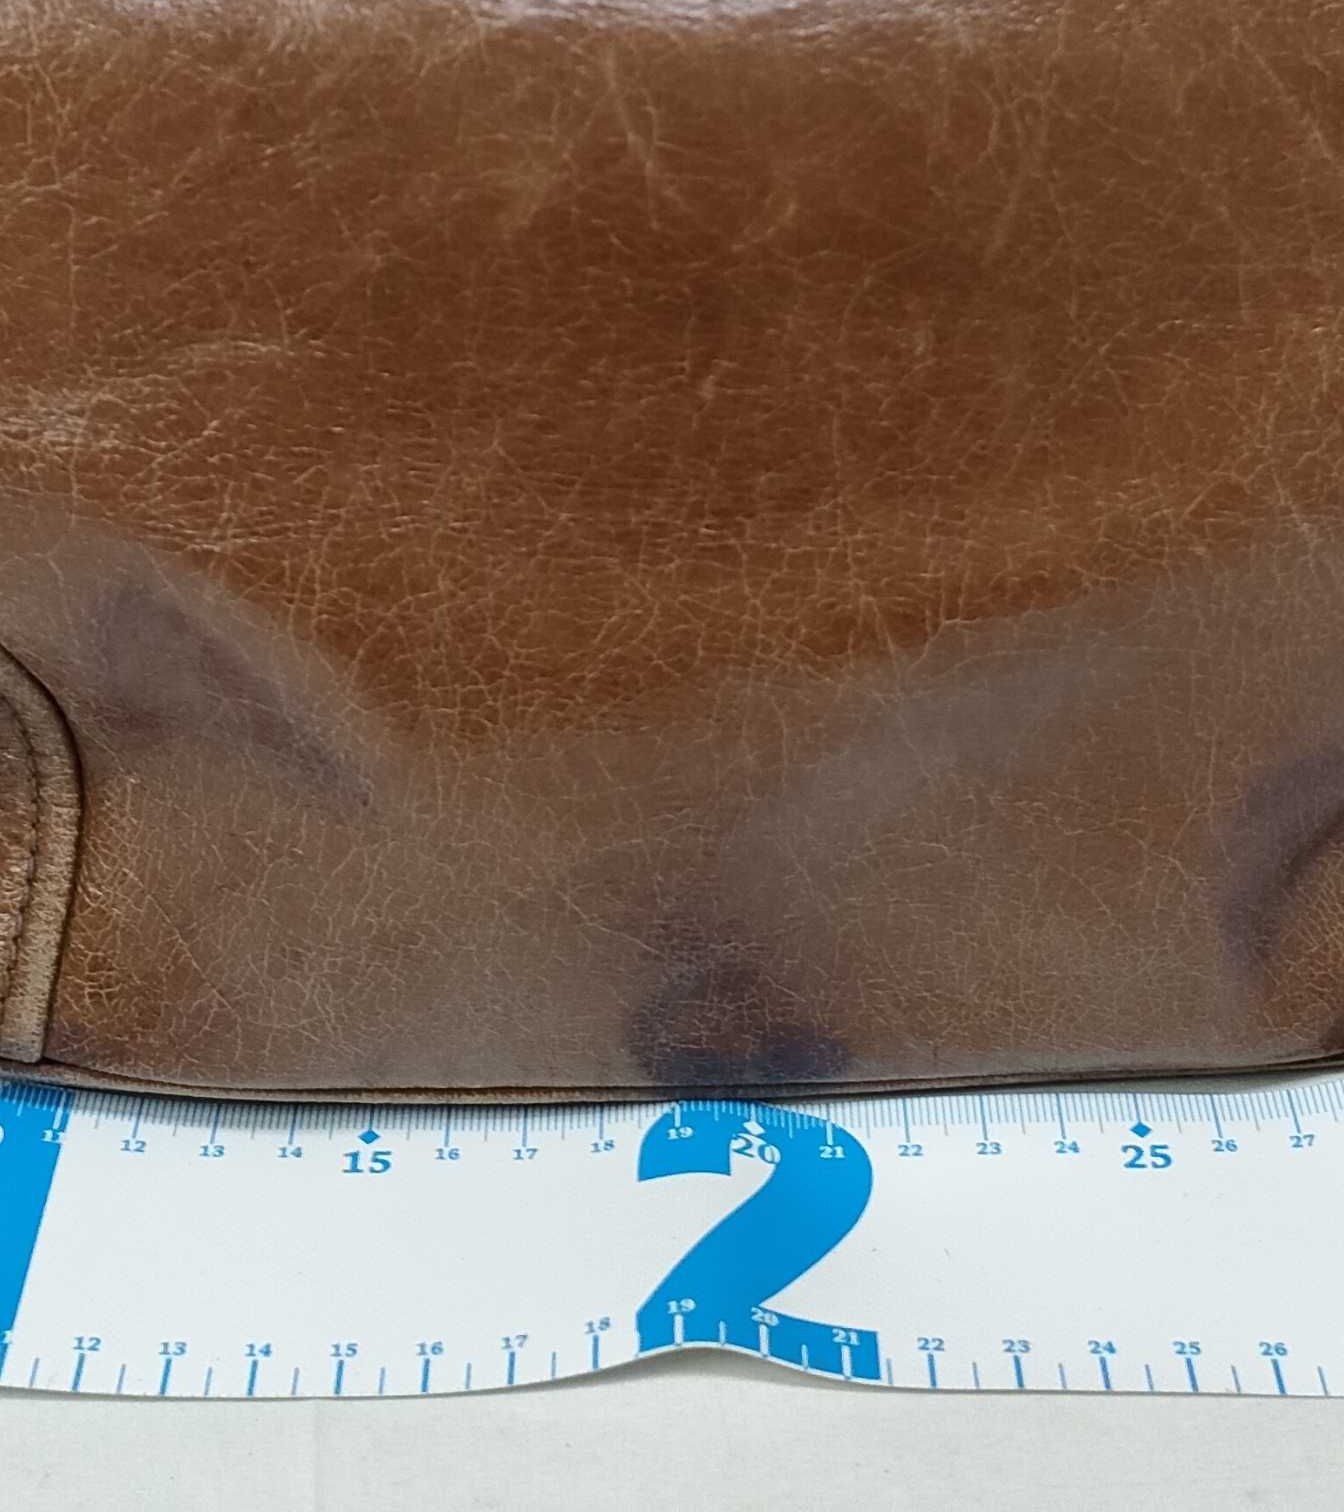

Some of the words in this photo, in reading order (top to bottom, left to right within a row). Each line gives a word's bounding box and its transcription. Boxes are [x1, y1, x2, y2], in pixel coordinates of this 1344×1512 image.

[42, 1129, 66, 1144] 11
[120, 1139, 147, 1153] 12
[199, 1144, 225, 1158] 13
[277, 1147, 303, 1159] 14
[342, 1150, 392, 1174] 15
[435, 1148, 461, 1161] 16
[512, 1147, 538, 1161] 17
[590, 1139, 615, 1153] 18
[666, 1126, 694, 1140] 19
[731, 1131, 782, 1165] 20
[819, 1145, 846, 1159] 21
[898, 1144, 924, 1158] 22
[976, 1141, 1003, 1155] 23
[1054, 1140, 1081, 1155] 24
[1120, 1144, 1173, 1170] 25
[1211, 1138, 1239, 1153] 26
[1289, 1134, 1315, 1149] 27
[636, 1098, 881, 1380] 2
[73, 1337, 101, 1351] 12
[158, 1341, 187, 1356] 13
[244, 1342, 272, 1357] 14
[330, 1342, 358, 1357] 15
[416, 1341, 444, 1356] 16
[500, 1334, 528, 1350] 17
[584, 1317, 612, 1334] 18
[666, 1298, 697, 1314] 19
[832, 1329, 860, 1345] 21
[917, 1337, 945, 1351] 22
[1002, 1339, 1031, 1353] 23
[1088, 1340, 1116, 1354] 24
[1173, 1341, 1202, 1355] 25
[1258, 1342, 1288, 1356] 26
